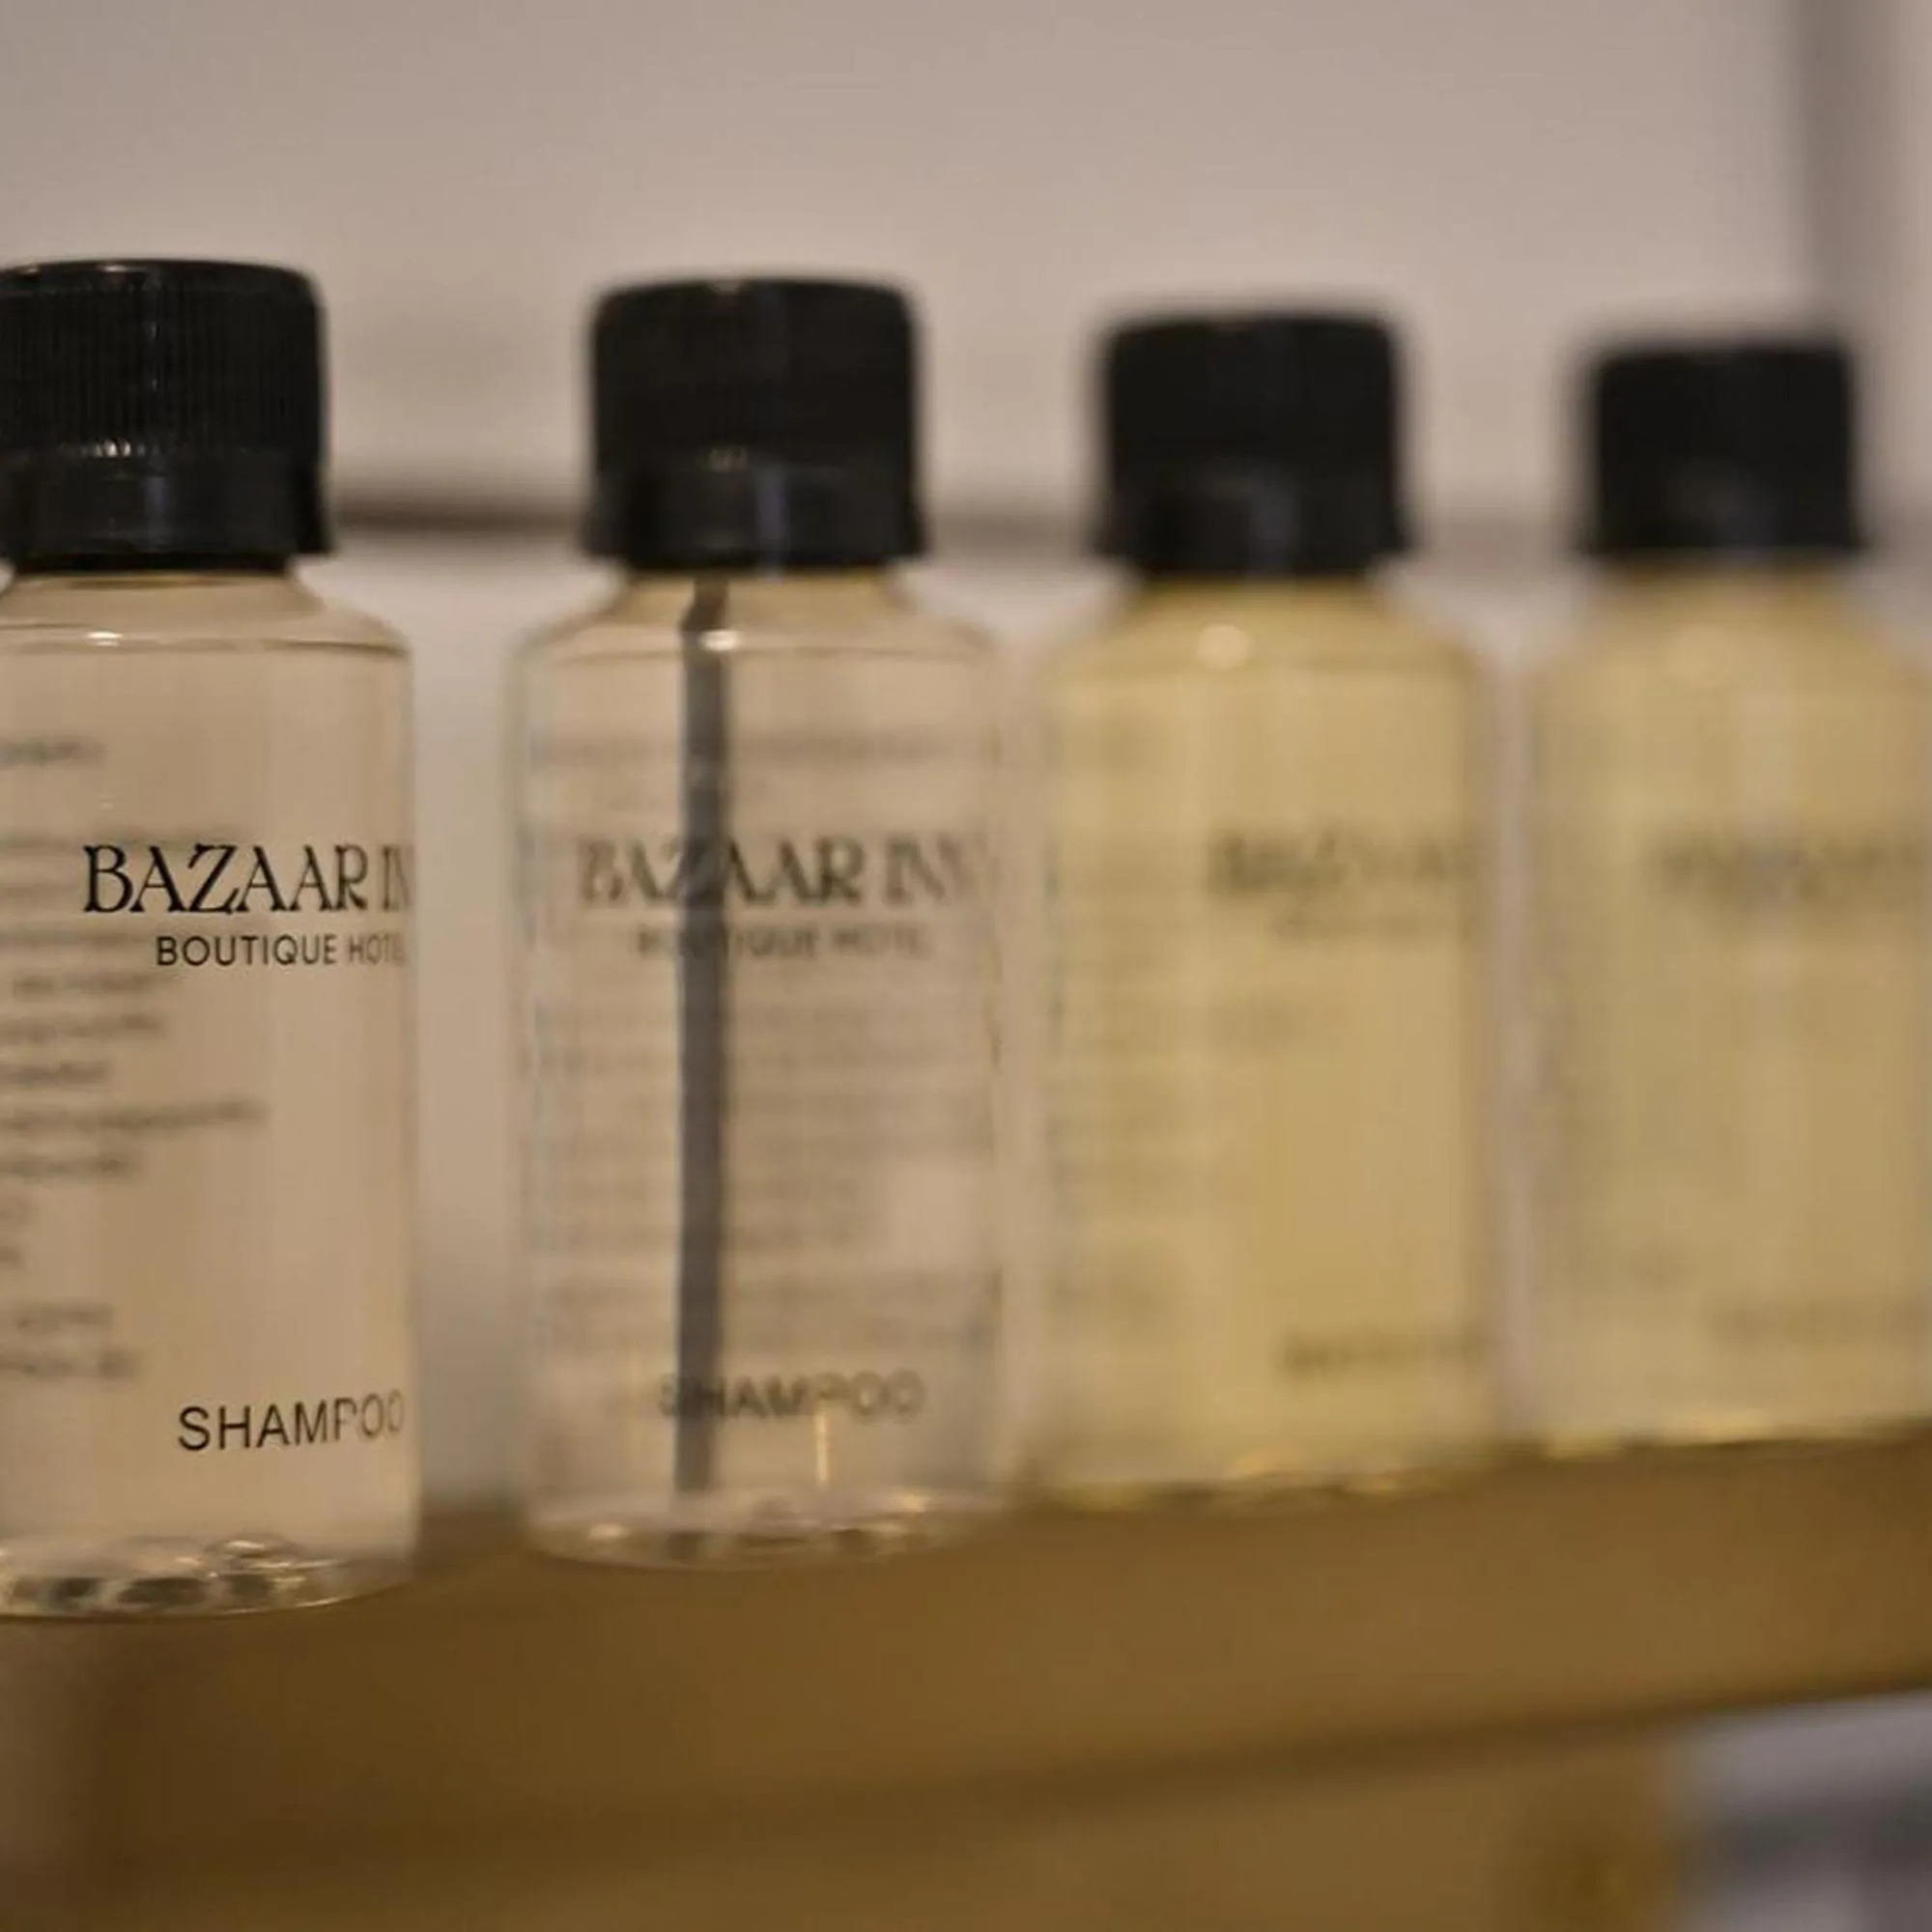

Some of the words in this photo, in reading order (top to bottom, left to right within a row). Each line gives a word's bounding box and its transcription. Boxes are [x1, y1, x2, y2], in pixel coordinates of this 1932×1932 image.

[82, 842, 368, 915] BAZAAR
[156, 933, 338, 967] BOUTIQUE
[178, 1388, 404, 1452] SHAMPOO
